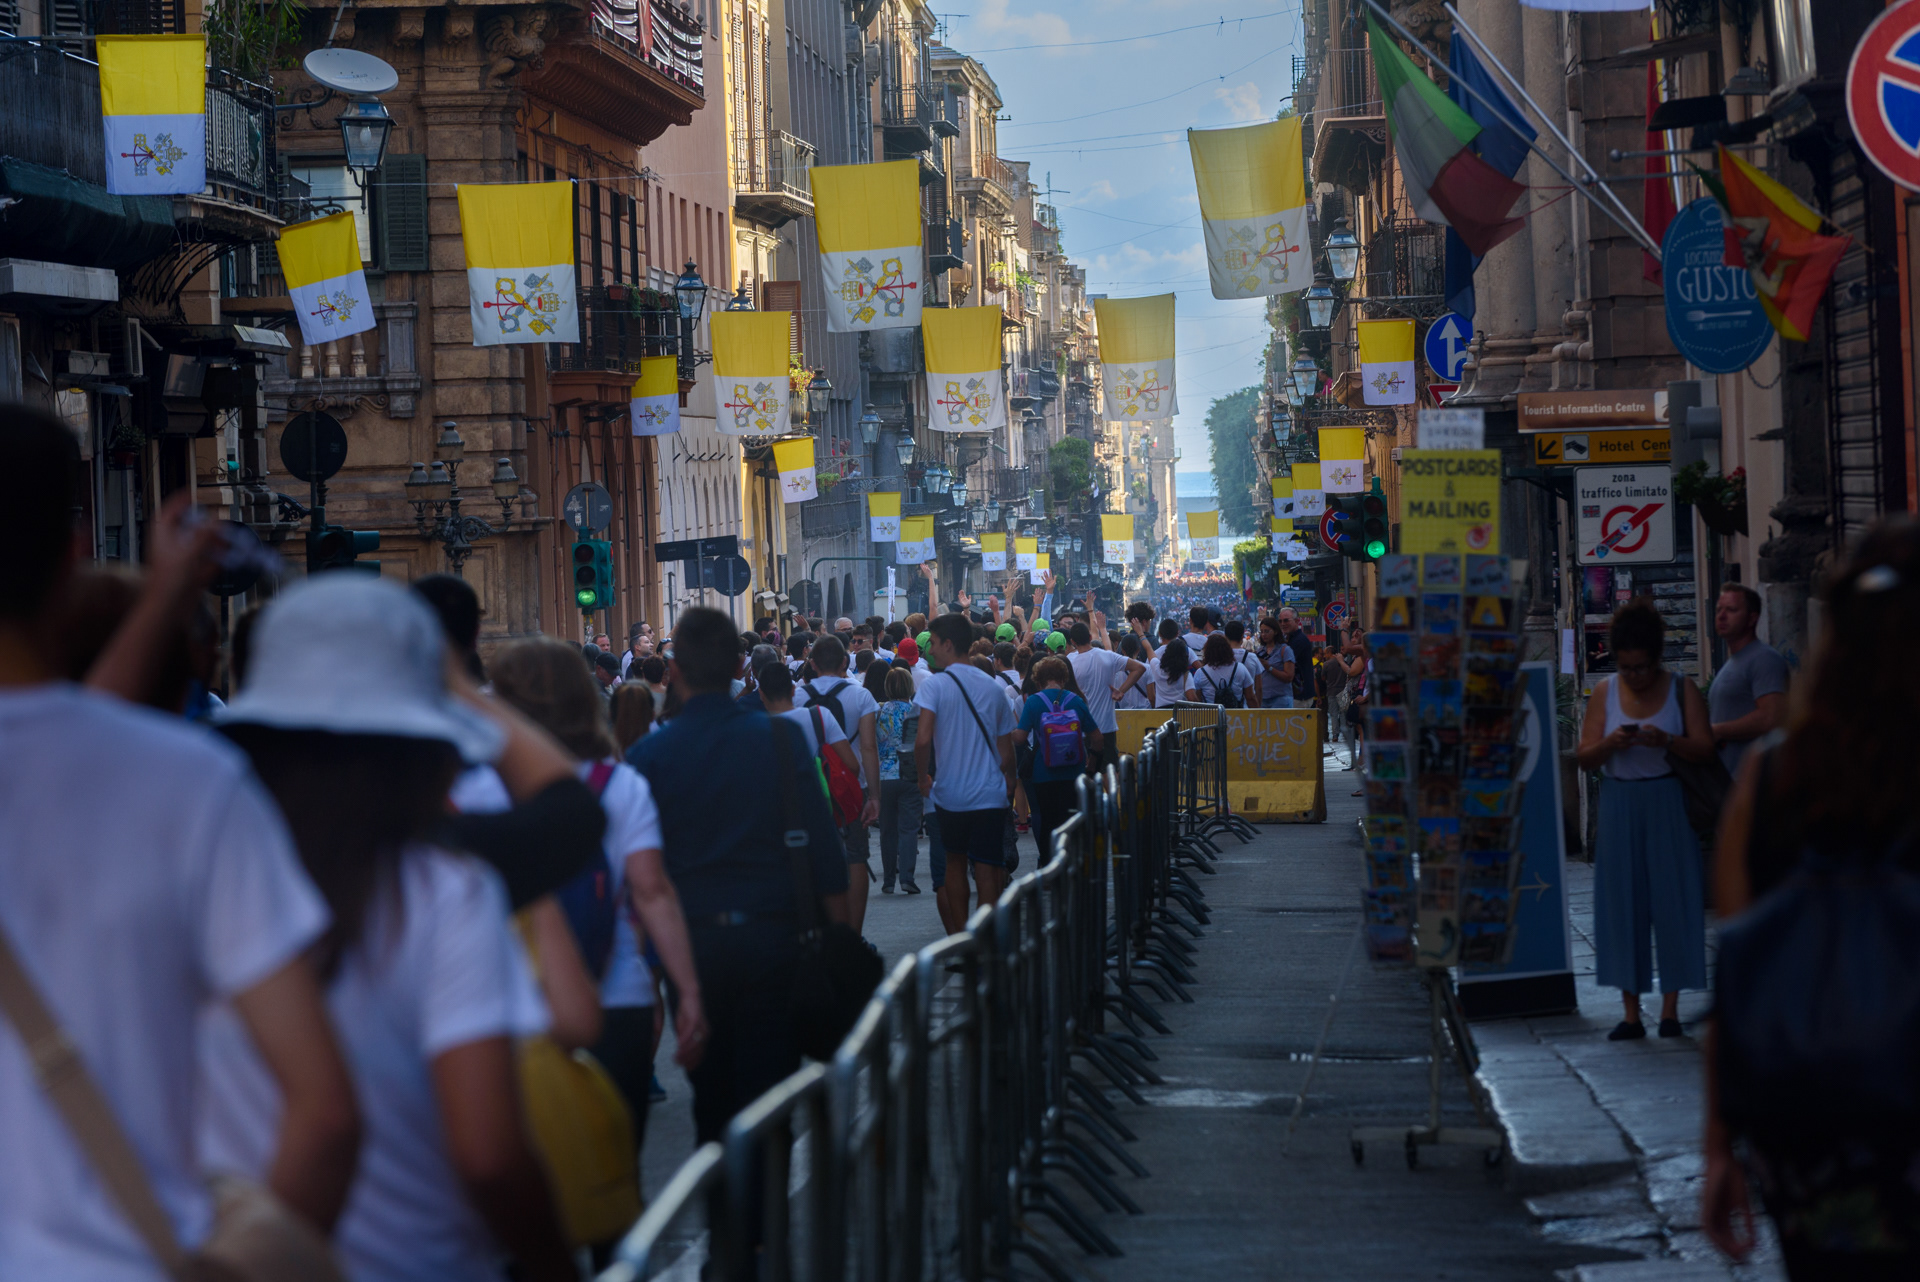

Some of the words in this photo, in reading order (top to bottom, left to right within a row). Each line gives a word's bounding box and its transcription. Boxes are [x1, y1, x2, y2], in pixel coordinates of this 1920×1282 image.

[1523, 405, 1555, 416] Tourist
[1558, 403, 1612, 415] Information
[1615, 402, 1646, 412] Centre
[1599, 440, 1635, 452] Hotel
[1402, 458, 1499, 477] POSTCARDS
[1612, 473, 1636, 483] zona
[1581, 486, 1622, 499] traffico
[1625, 485, 1668, 498] limitato
[1408, 501, 1491, 519] MAILING
